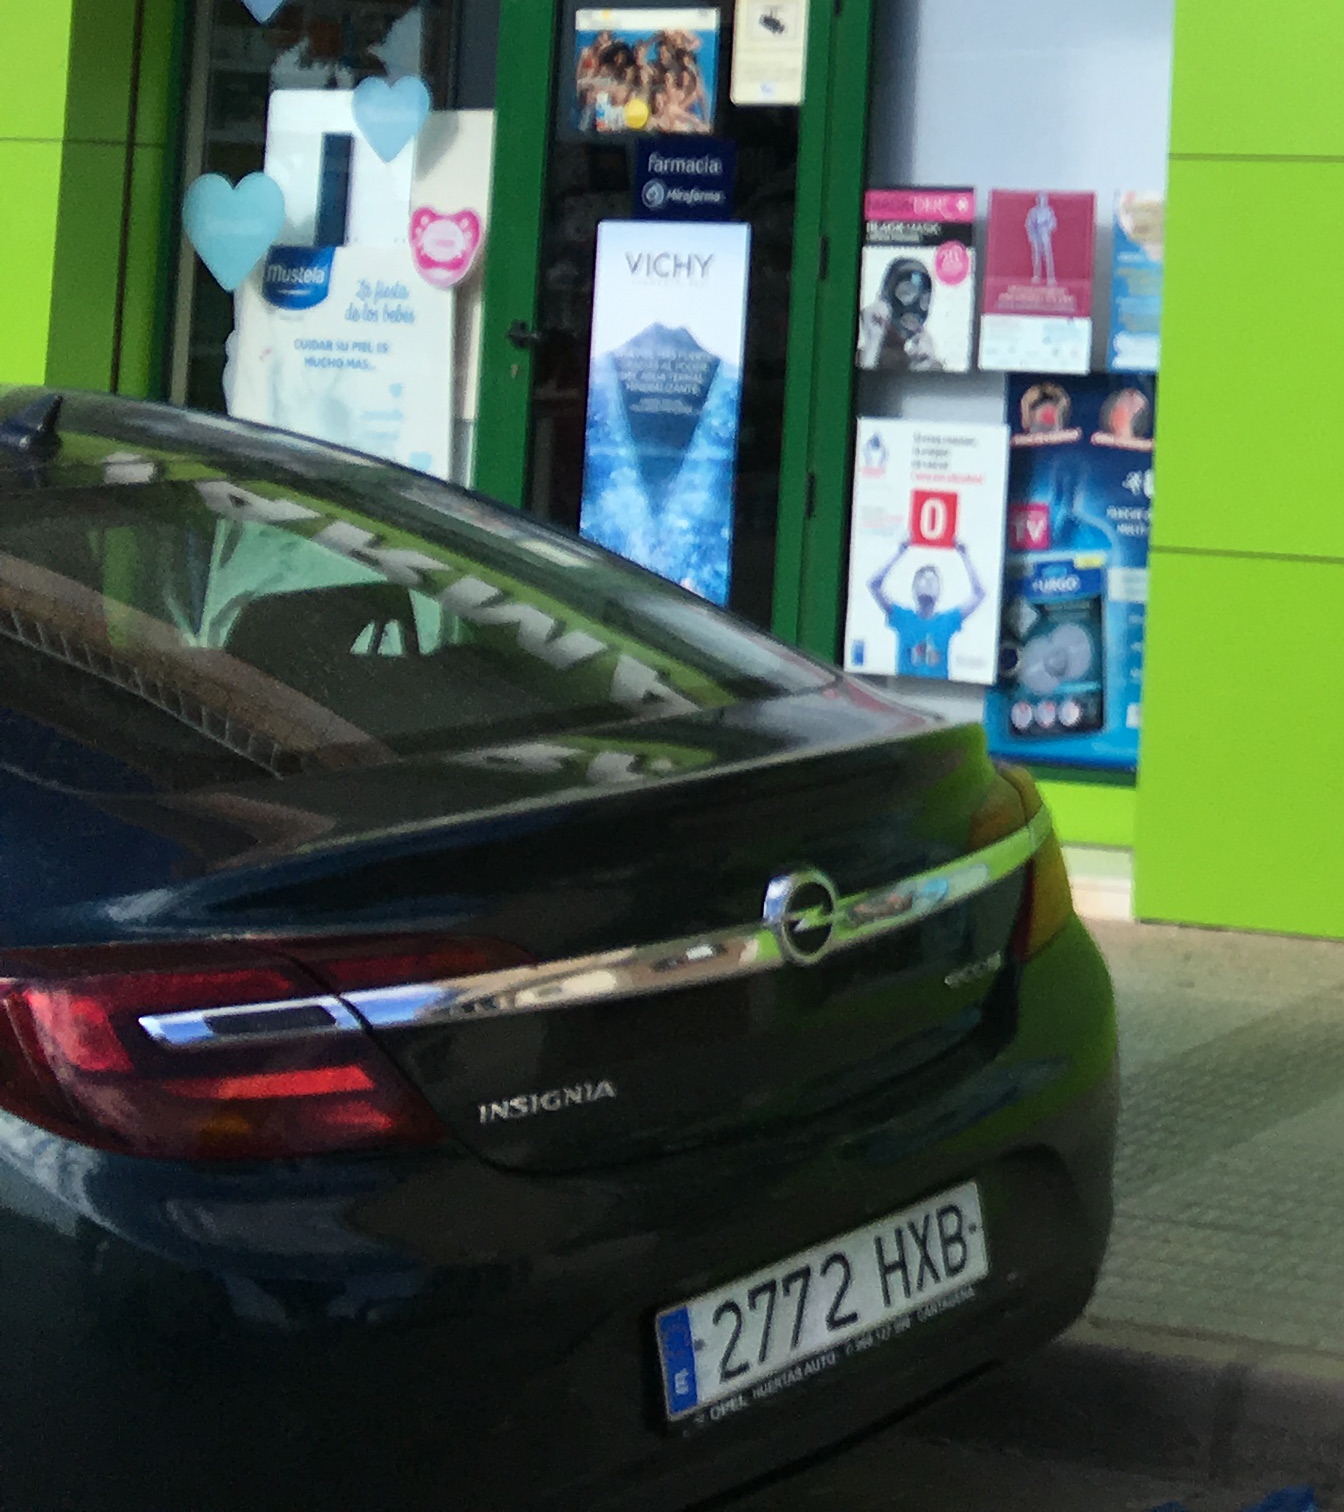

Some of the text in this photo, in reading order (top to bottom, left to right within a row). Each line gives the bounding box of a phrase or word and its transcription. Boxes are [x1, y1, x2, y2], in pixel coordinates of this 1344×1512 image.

[266, 265, 325, 285] Mustela
[625, 252, 714, 279] VICHY
[920, 496, 948, 541] 0
[479, 1080, 616, 1125] INSIGNIA
[711, 1203, 969, 1385] 2772 HXB
